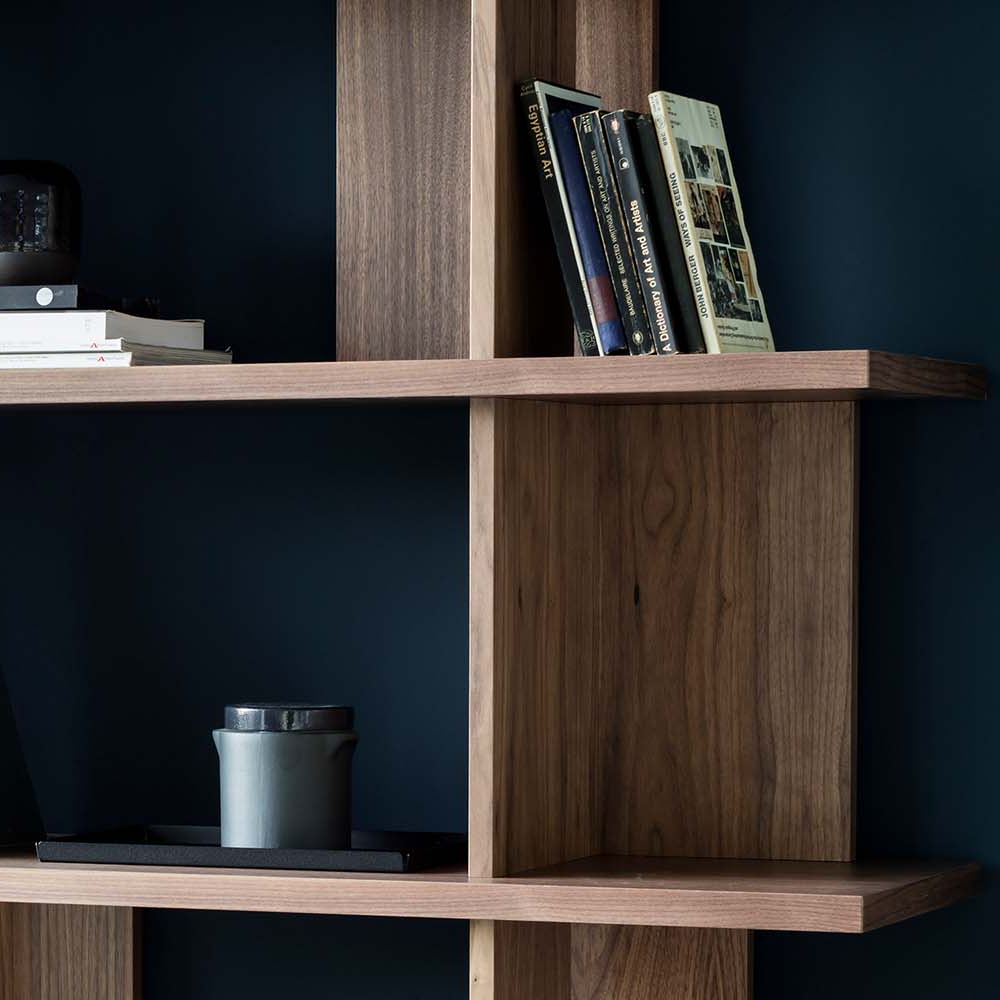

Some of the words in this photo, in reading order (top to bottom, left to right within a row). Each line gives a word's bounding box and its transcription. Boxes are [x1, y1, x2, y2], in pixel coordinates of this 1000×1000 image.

[528, 103, 547, 155] Egyptian
[541, 159, 554, 179] Art
[590, 149, 601, 174] ARTISTS
[596, 175, 604, 189] AND
[669, 172, 683, 207] SEEING
[599, 190, 607, 202] ART
[602, 203, 610, 213] ON
[630, 199, 645, 233] Artists
[677, 209, 686, 221] OF
[606, 213, 618, 244] WRITINGS
[681, 222, 692, 248] WAYS
[612, 243, 625, 274] SELECTED
[636, 237, 650, 256] and
[642, 257, 656, 278] Art
[688, 255, 703, 293] BERGER
[646, 279, 657, 288] of
[621, 278, 636, 316] BAUDELAIRE
[696, 294, 709, 319] JOHN
[651, 290, 670, 341] Dictionary
[662, 342, 673, 352] A
